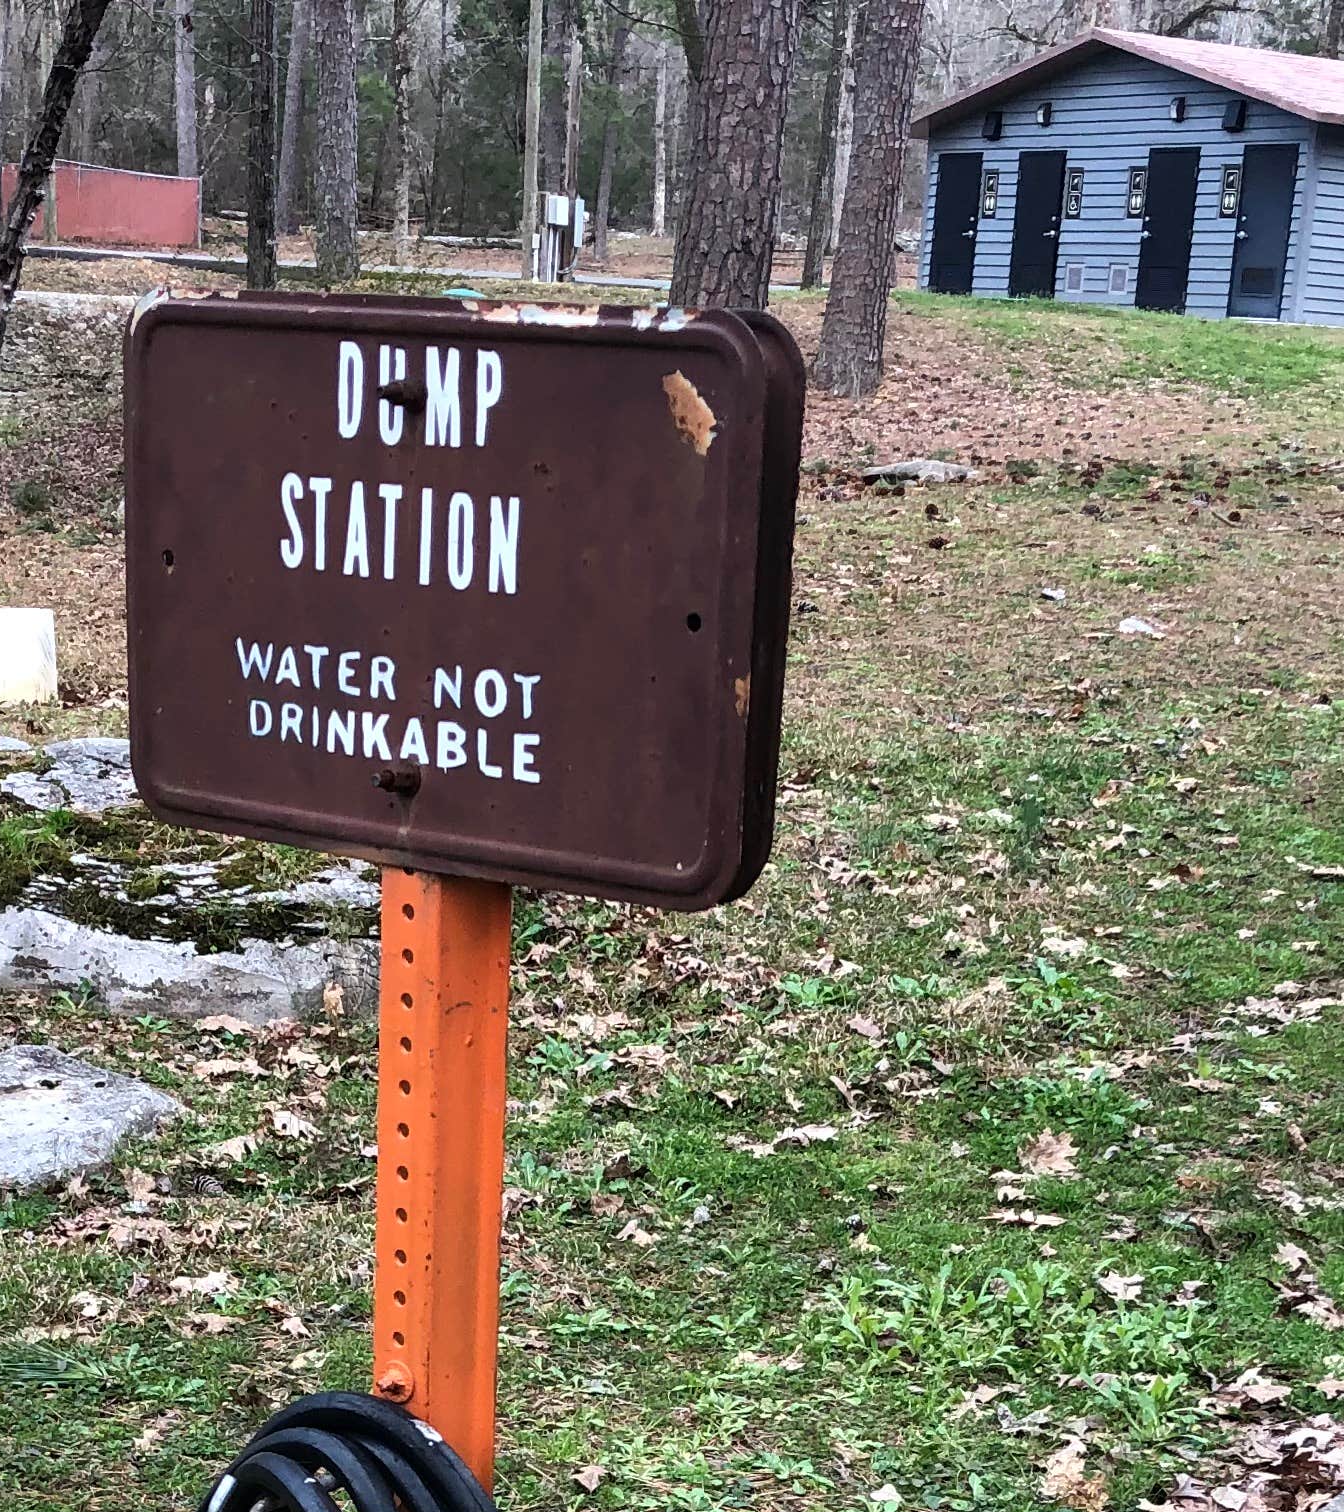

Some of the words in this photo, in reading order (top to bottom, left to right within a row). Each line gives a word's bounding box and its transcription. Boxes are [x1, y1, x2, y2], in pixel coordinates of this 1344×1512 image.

[337, 340, 502, 448] DUMP
[280, 472, 520, 594] STATION
[236, 636, 396, 701] WATER
[433, 665, 541, 720] NOT
[249, 699, 541, 784] DRINKABLE
